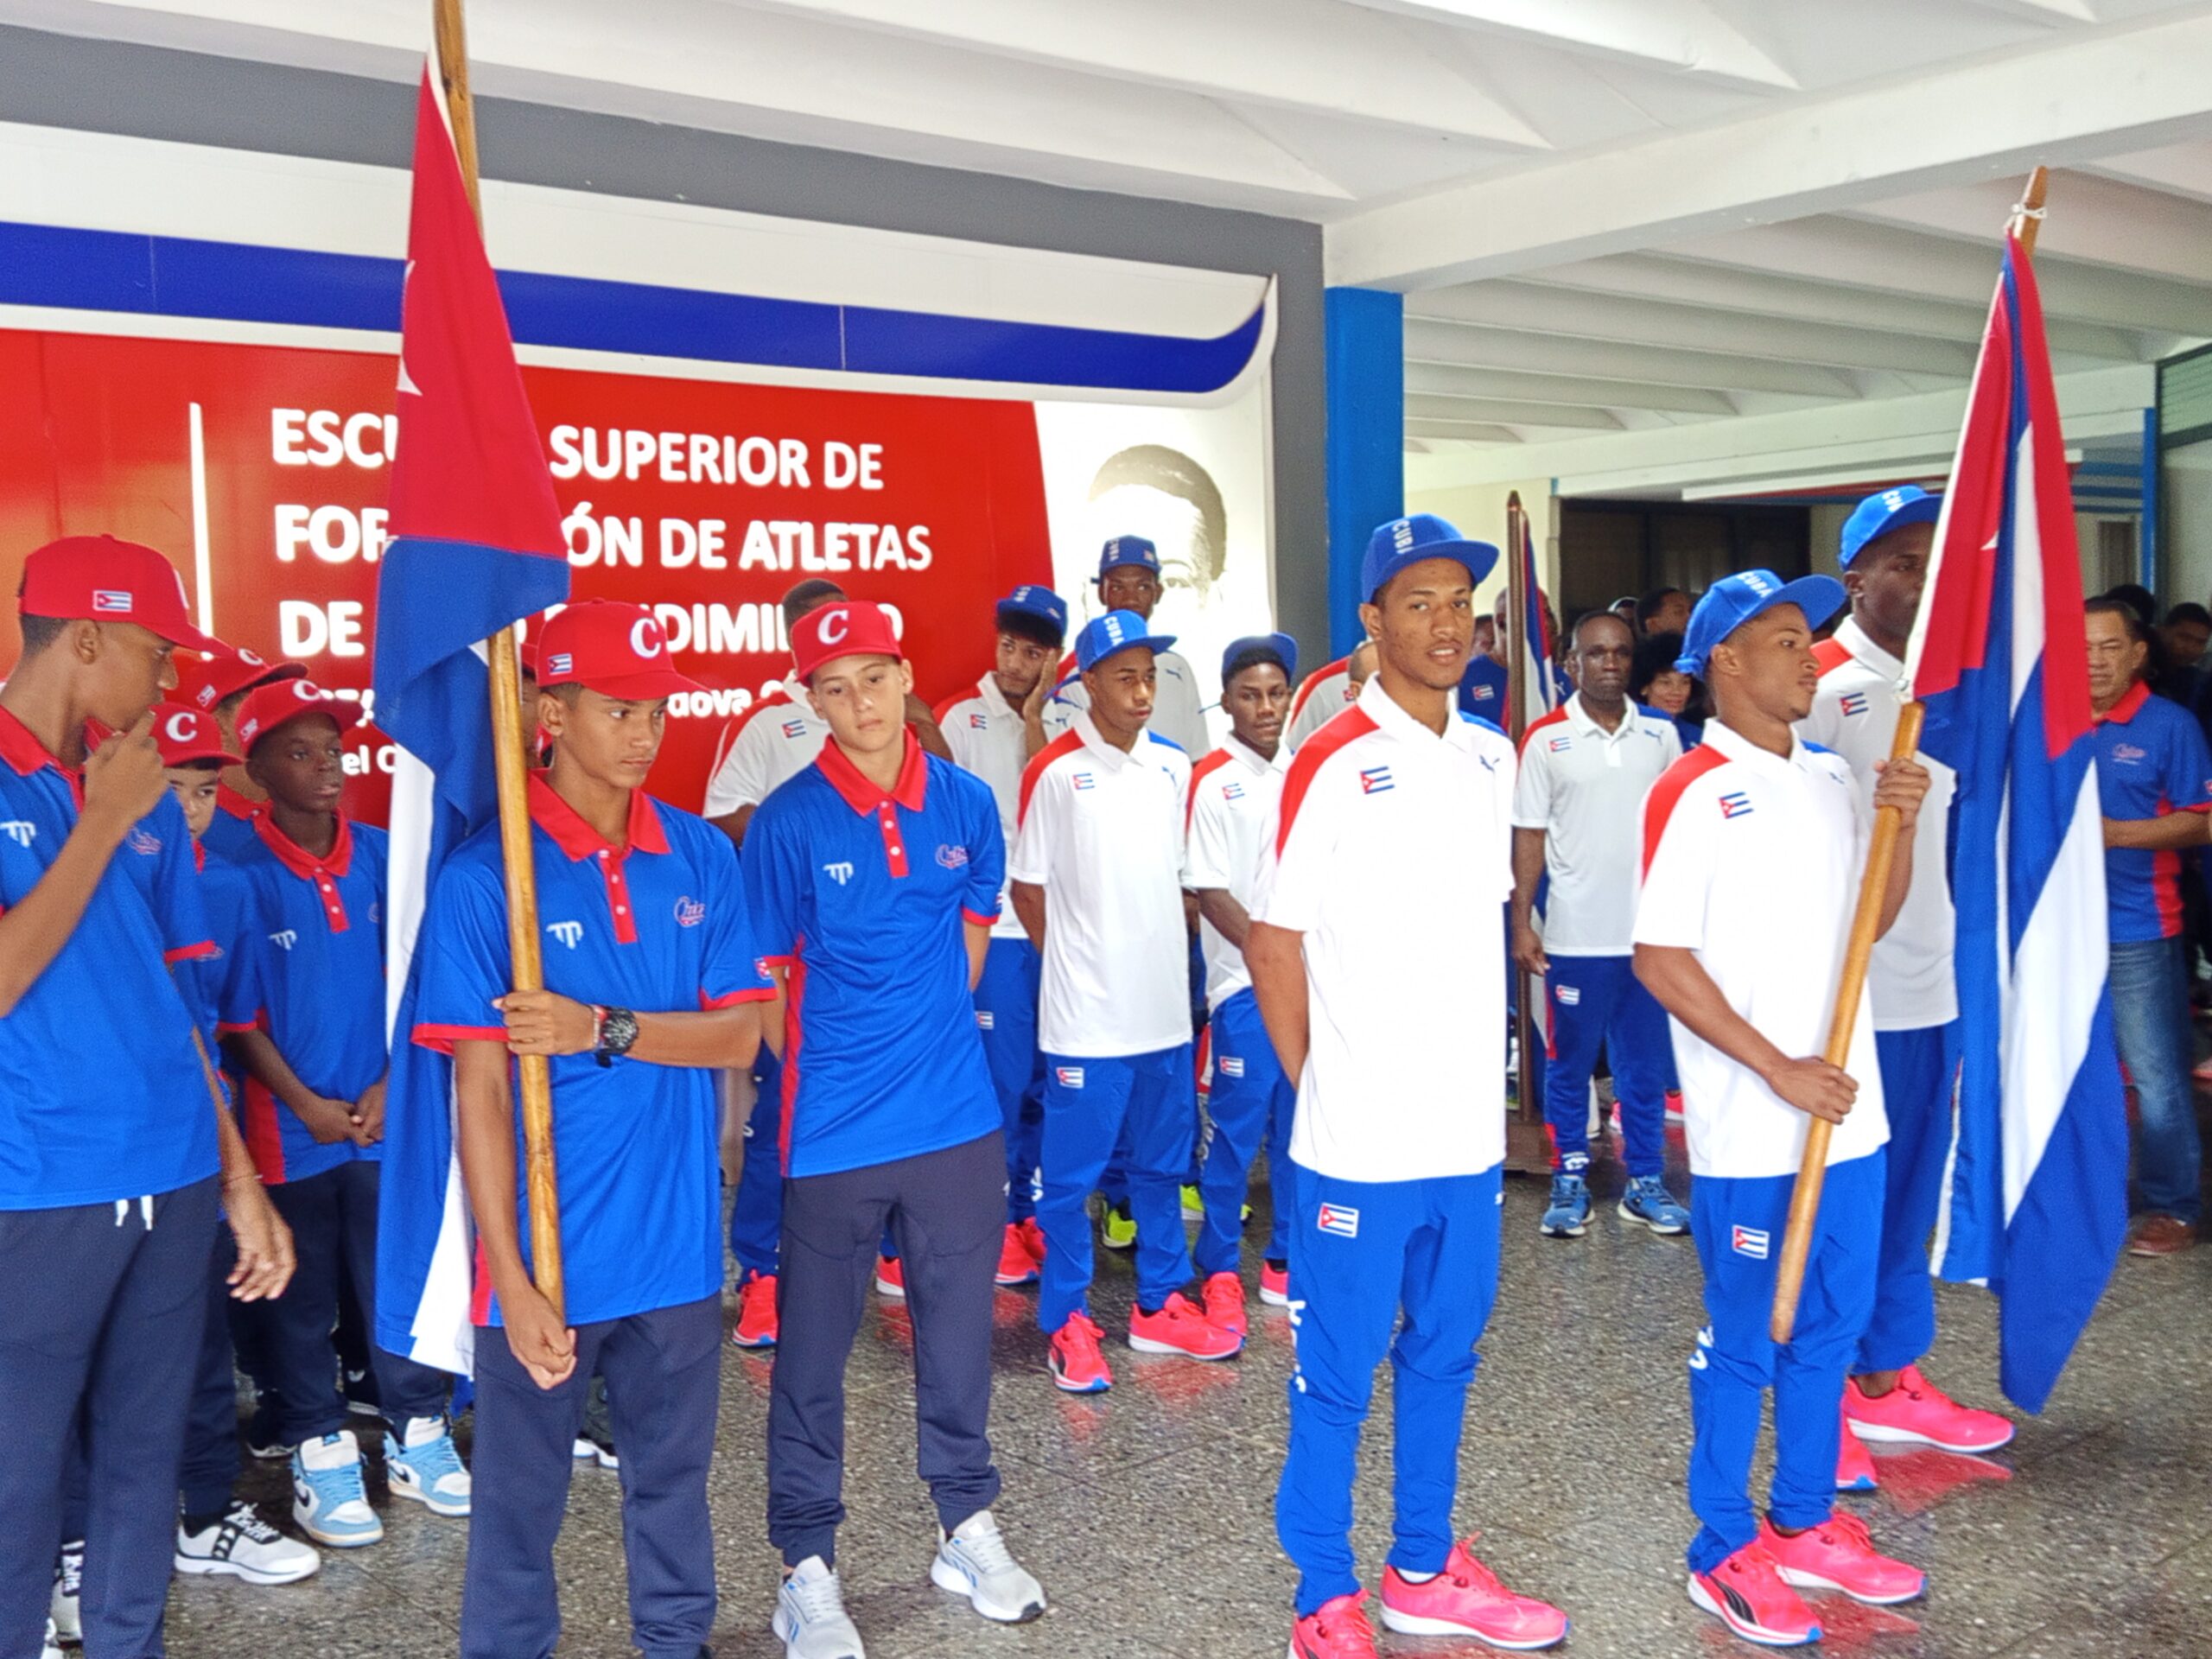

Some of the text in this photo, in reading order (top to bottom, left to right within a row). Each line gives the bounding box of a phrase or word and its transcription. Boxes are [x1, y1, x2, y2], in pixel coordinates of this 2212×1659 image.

[549, 424, 811, 488] SUPERIOR
[823, 441, 884, 490] DE
[659, 518, 728, 569] DE
[738, 519, 932, 572] ATLETAS
[1735, 571, 1774, 599] CUBA
[278, 600, 365, 658] DE
[631, 616, 662, 659] C
[817, 609, 849, 645] C
[165, 712, 197, 741] C
